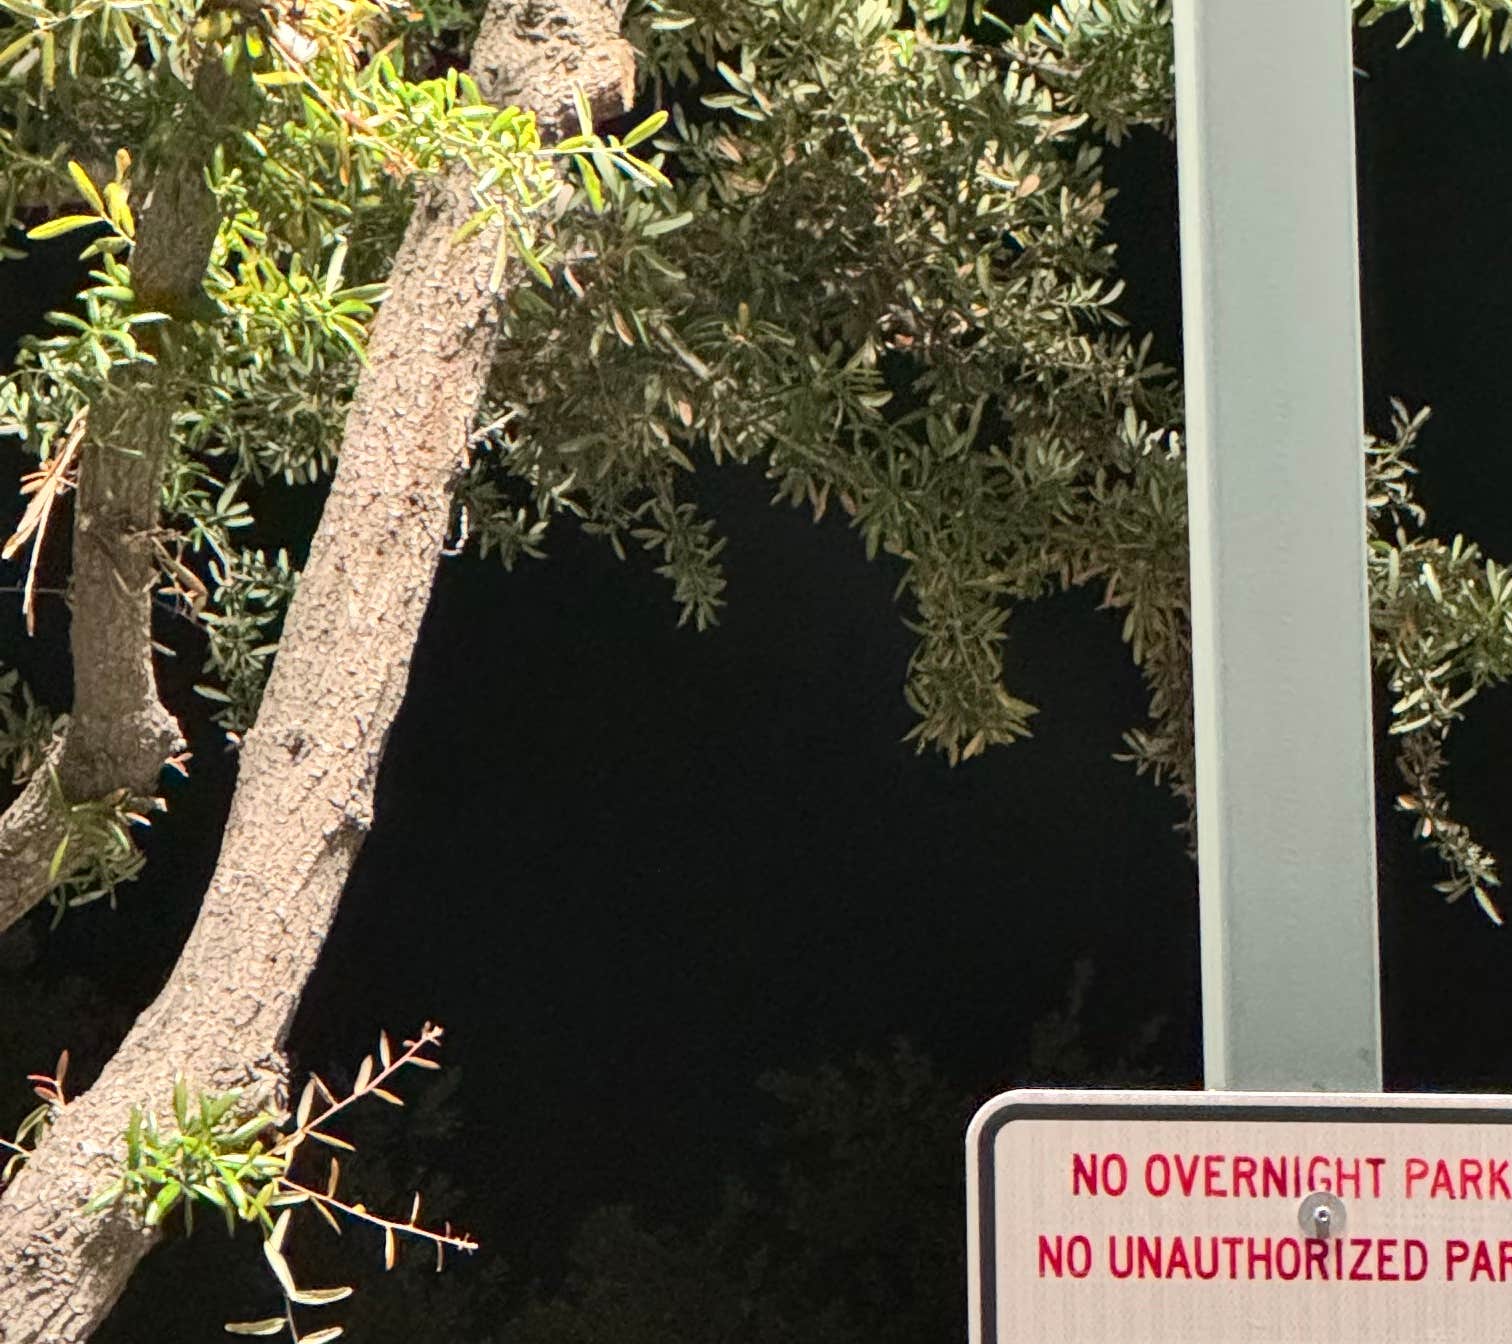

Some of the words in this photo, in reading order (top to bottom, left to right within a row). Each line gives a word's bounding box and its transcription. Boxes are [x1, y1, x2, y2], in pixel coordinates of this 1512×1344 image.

[1071, 1151, 1129, 1198] NO
[1143, 1151, 1385, 1200] OVERNIGHT
[1037, 1233, 1094, 1280] NO
[1108, 1234, 1430, 1283] UNAUTHORIZED
